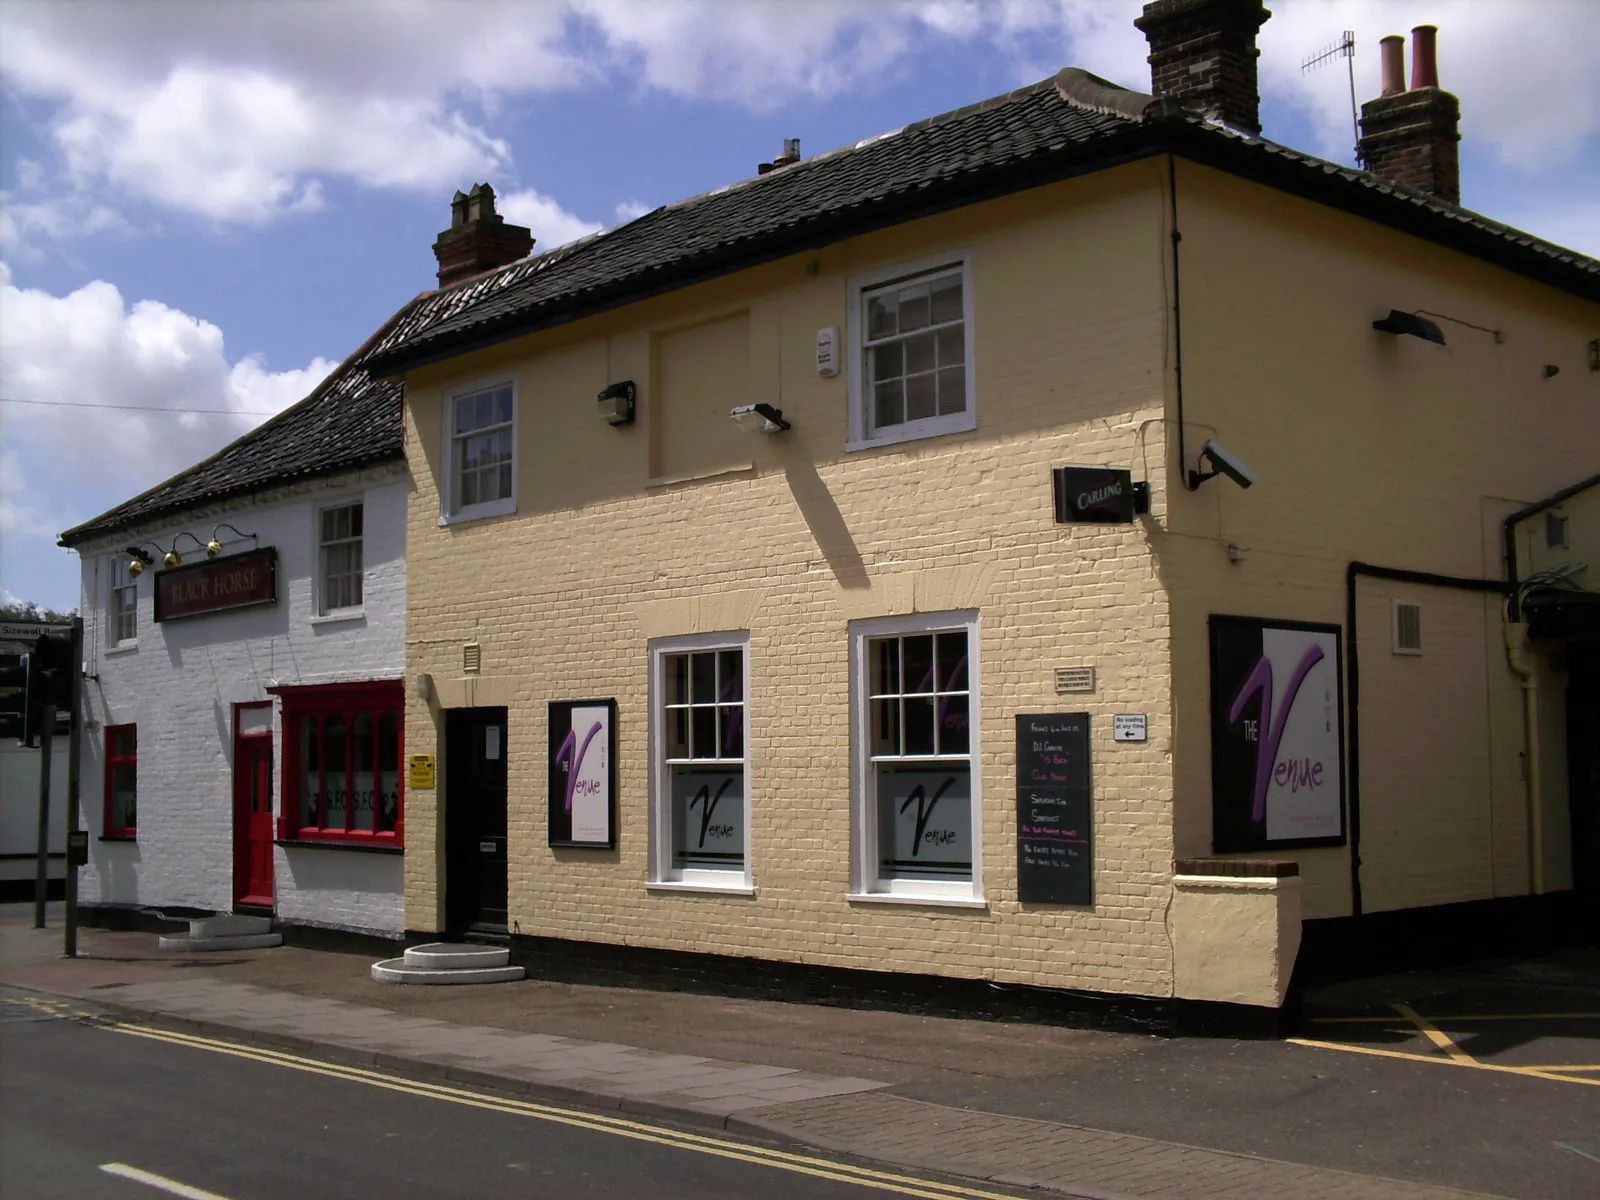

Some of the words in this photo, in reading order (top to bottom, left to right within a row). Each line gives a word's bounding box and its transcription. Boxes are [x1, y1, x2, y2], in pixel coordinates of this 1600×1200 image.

[1077, 482, 1122, 510] CARLING
[172, 578, 210, 604] BLACK
[214, 568, 258, 596] HORSE
[556, 721, 603, 811] Venue
[1229, 643, 1325, 823] Venue
[1243, 719, 1258, 742] THE
[689, 777, 734, 849] Venue
[900, 776, 957, 857] Venue
